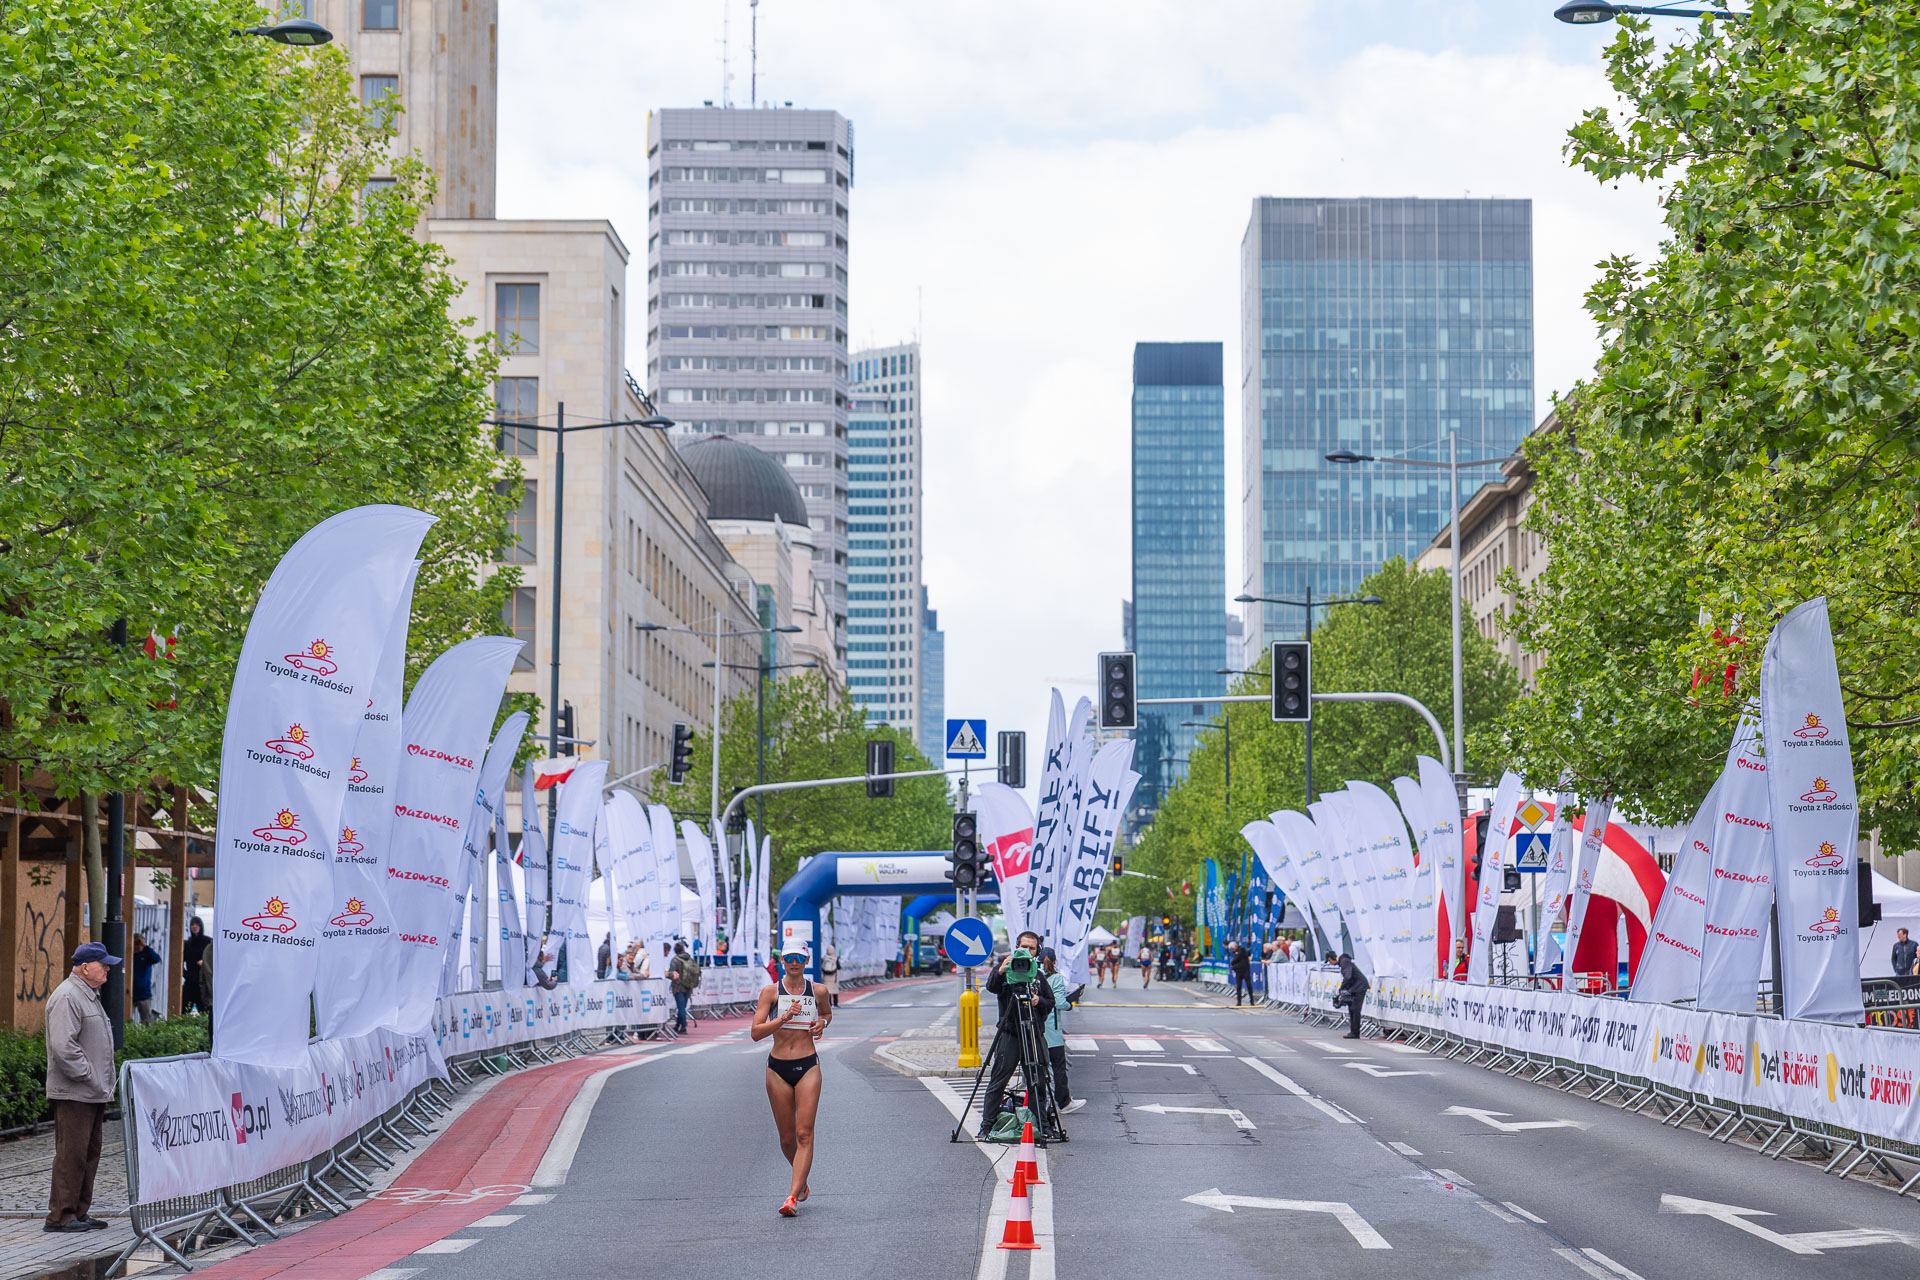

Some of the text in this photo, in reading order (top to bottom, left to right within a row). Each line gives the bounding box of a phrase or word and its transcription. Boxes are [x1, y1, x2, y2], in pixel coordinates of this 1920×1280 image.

[264, 660, 354, 695] Toyota z Radości
[1782, 739, 1808, 748] Toyota
[1815, 738, 1844, 746] Radości
[246, 748, 331, 780] Toyota z Radości
[1736, 757, 1766, 771] Mazo
[1788, 804, 1815, 813] Toyota
[1822, 803, 1853, 811] Radości
[233, 838, 270, 854] Toyota
[273, 846, 280, 854] z
[281, 845, 326, 861] Radości
[1793, 869, 1820, 878] Toyota
[222, 929, 315, 948] Toyota z Radości
[322, 931, 346, 939] oyota
[356, 925, 390, 936] Radości
[1797, 934, 1824, 943] Toyota
[803, 997, 813, 1006] 16
[1840, 1062, 1866, 1099] onet
